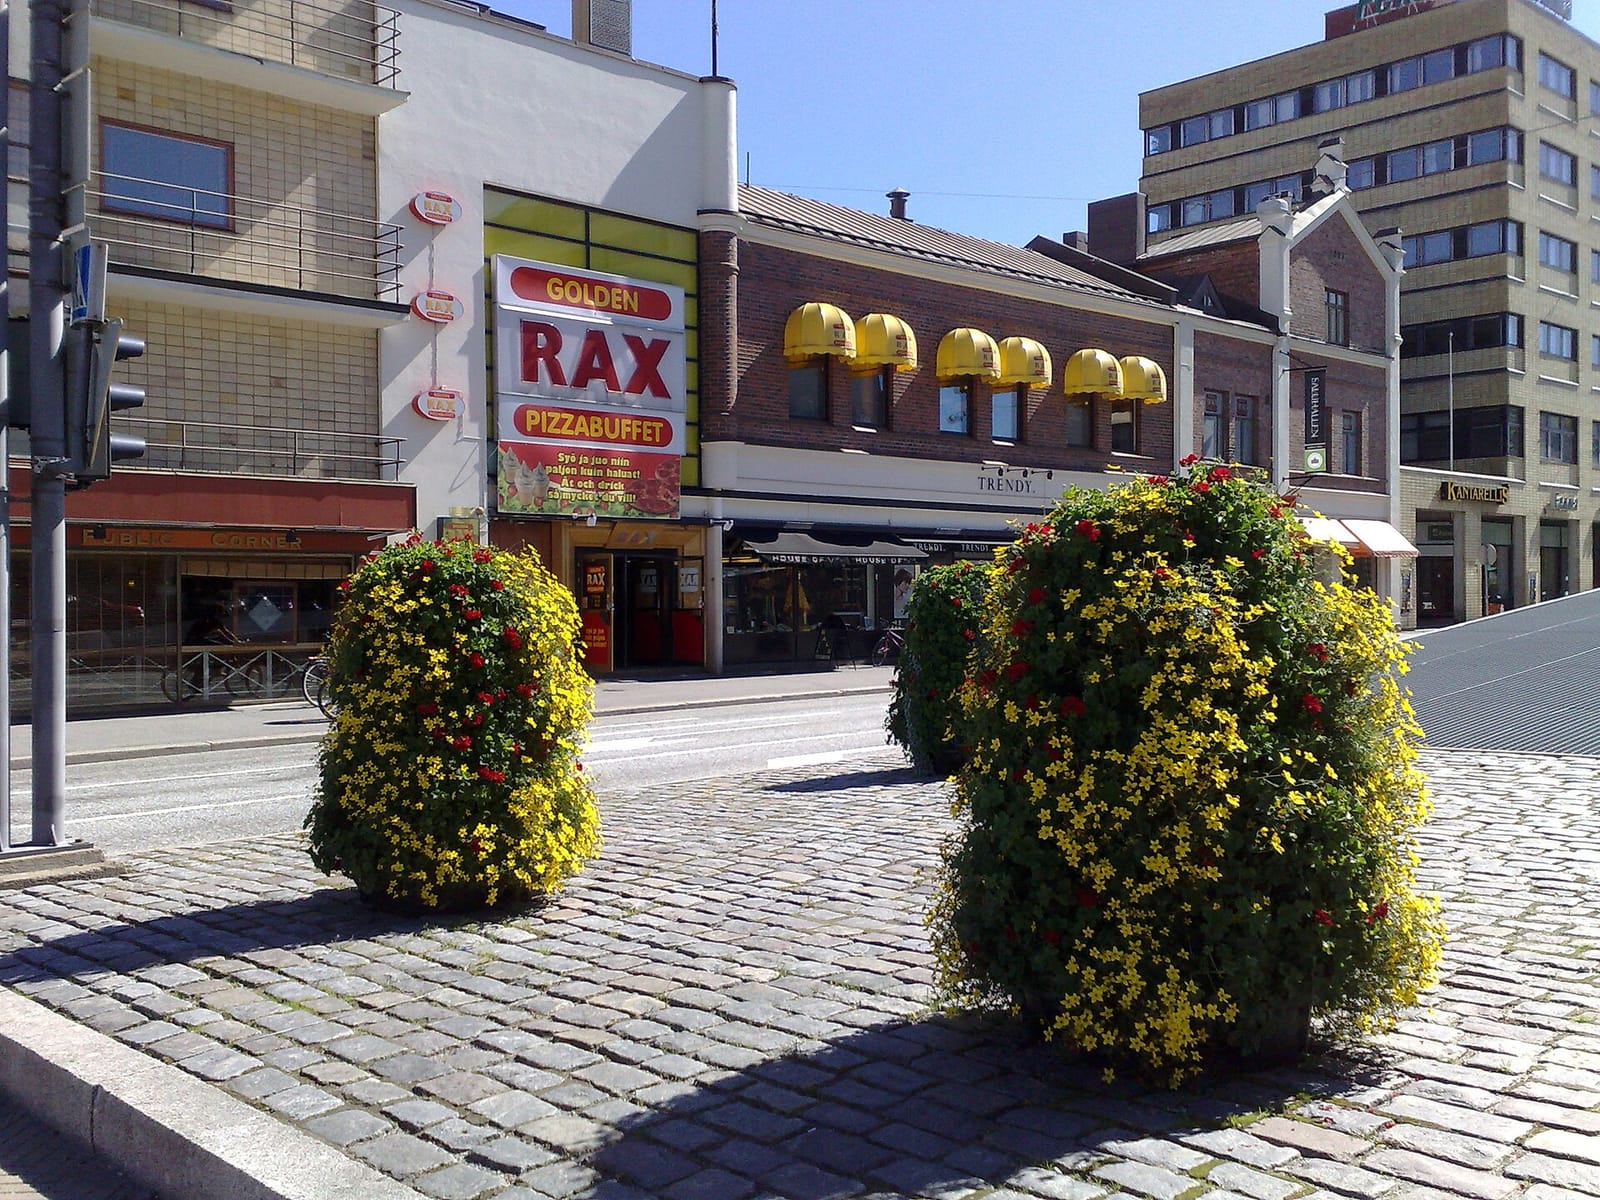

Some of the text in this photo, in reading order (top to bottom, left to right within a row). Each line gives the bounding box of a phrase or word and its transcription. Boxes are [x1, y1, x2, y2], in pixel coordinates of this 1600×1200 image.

[546, 277, 639, 313] GOLDEN
[520, 319, 671, 399] RAX
[525, 409, 664, 443] PIZZABUFFET
[557, 452, 630, 466] Syö ja juo niin
[545, 465, 641, 479] paljon kuin haluat!
[577, 479, 595, 489] och
[597, 480, 625, 490] drick
[977, 476, 1036, 494] TRENDY.
[1447, 482, 1508, 503] KANTARELLIS
[601, 492, 615, 502] du
[617, 493, 637, 503] vill!
[586, 573, 605, 586] RAX
